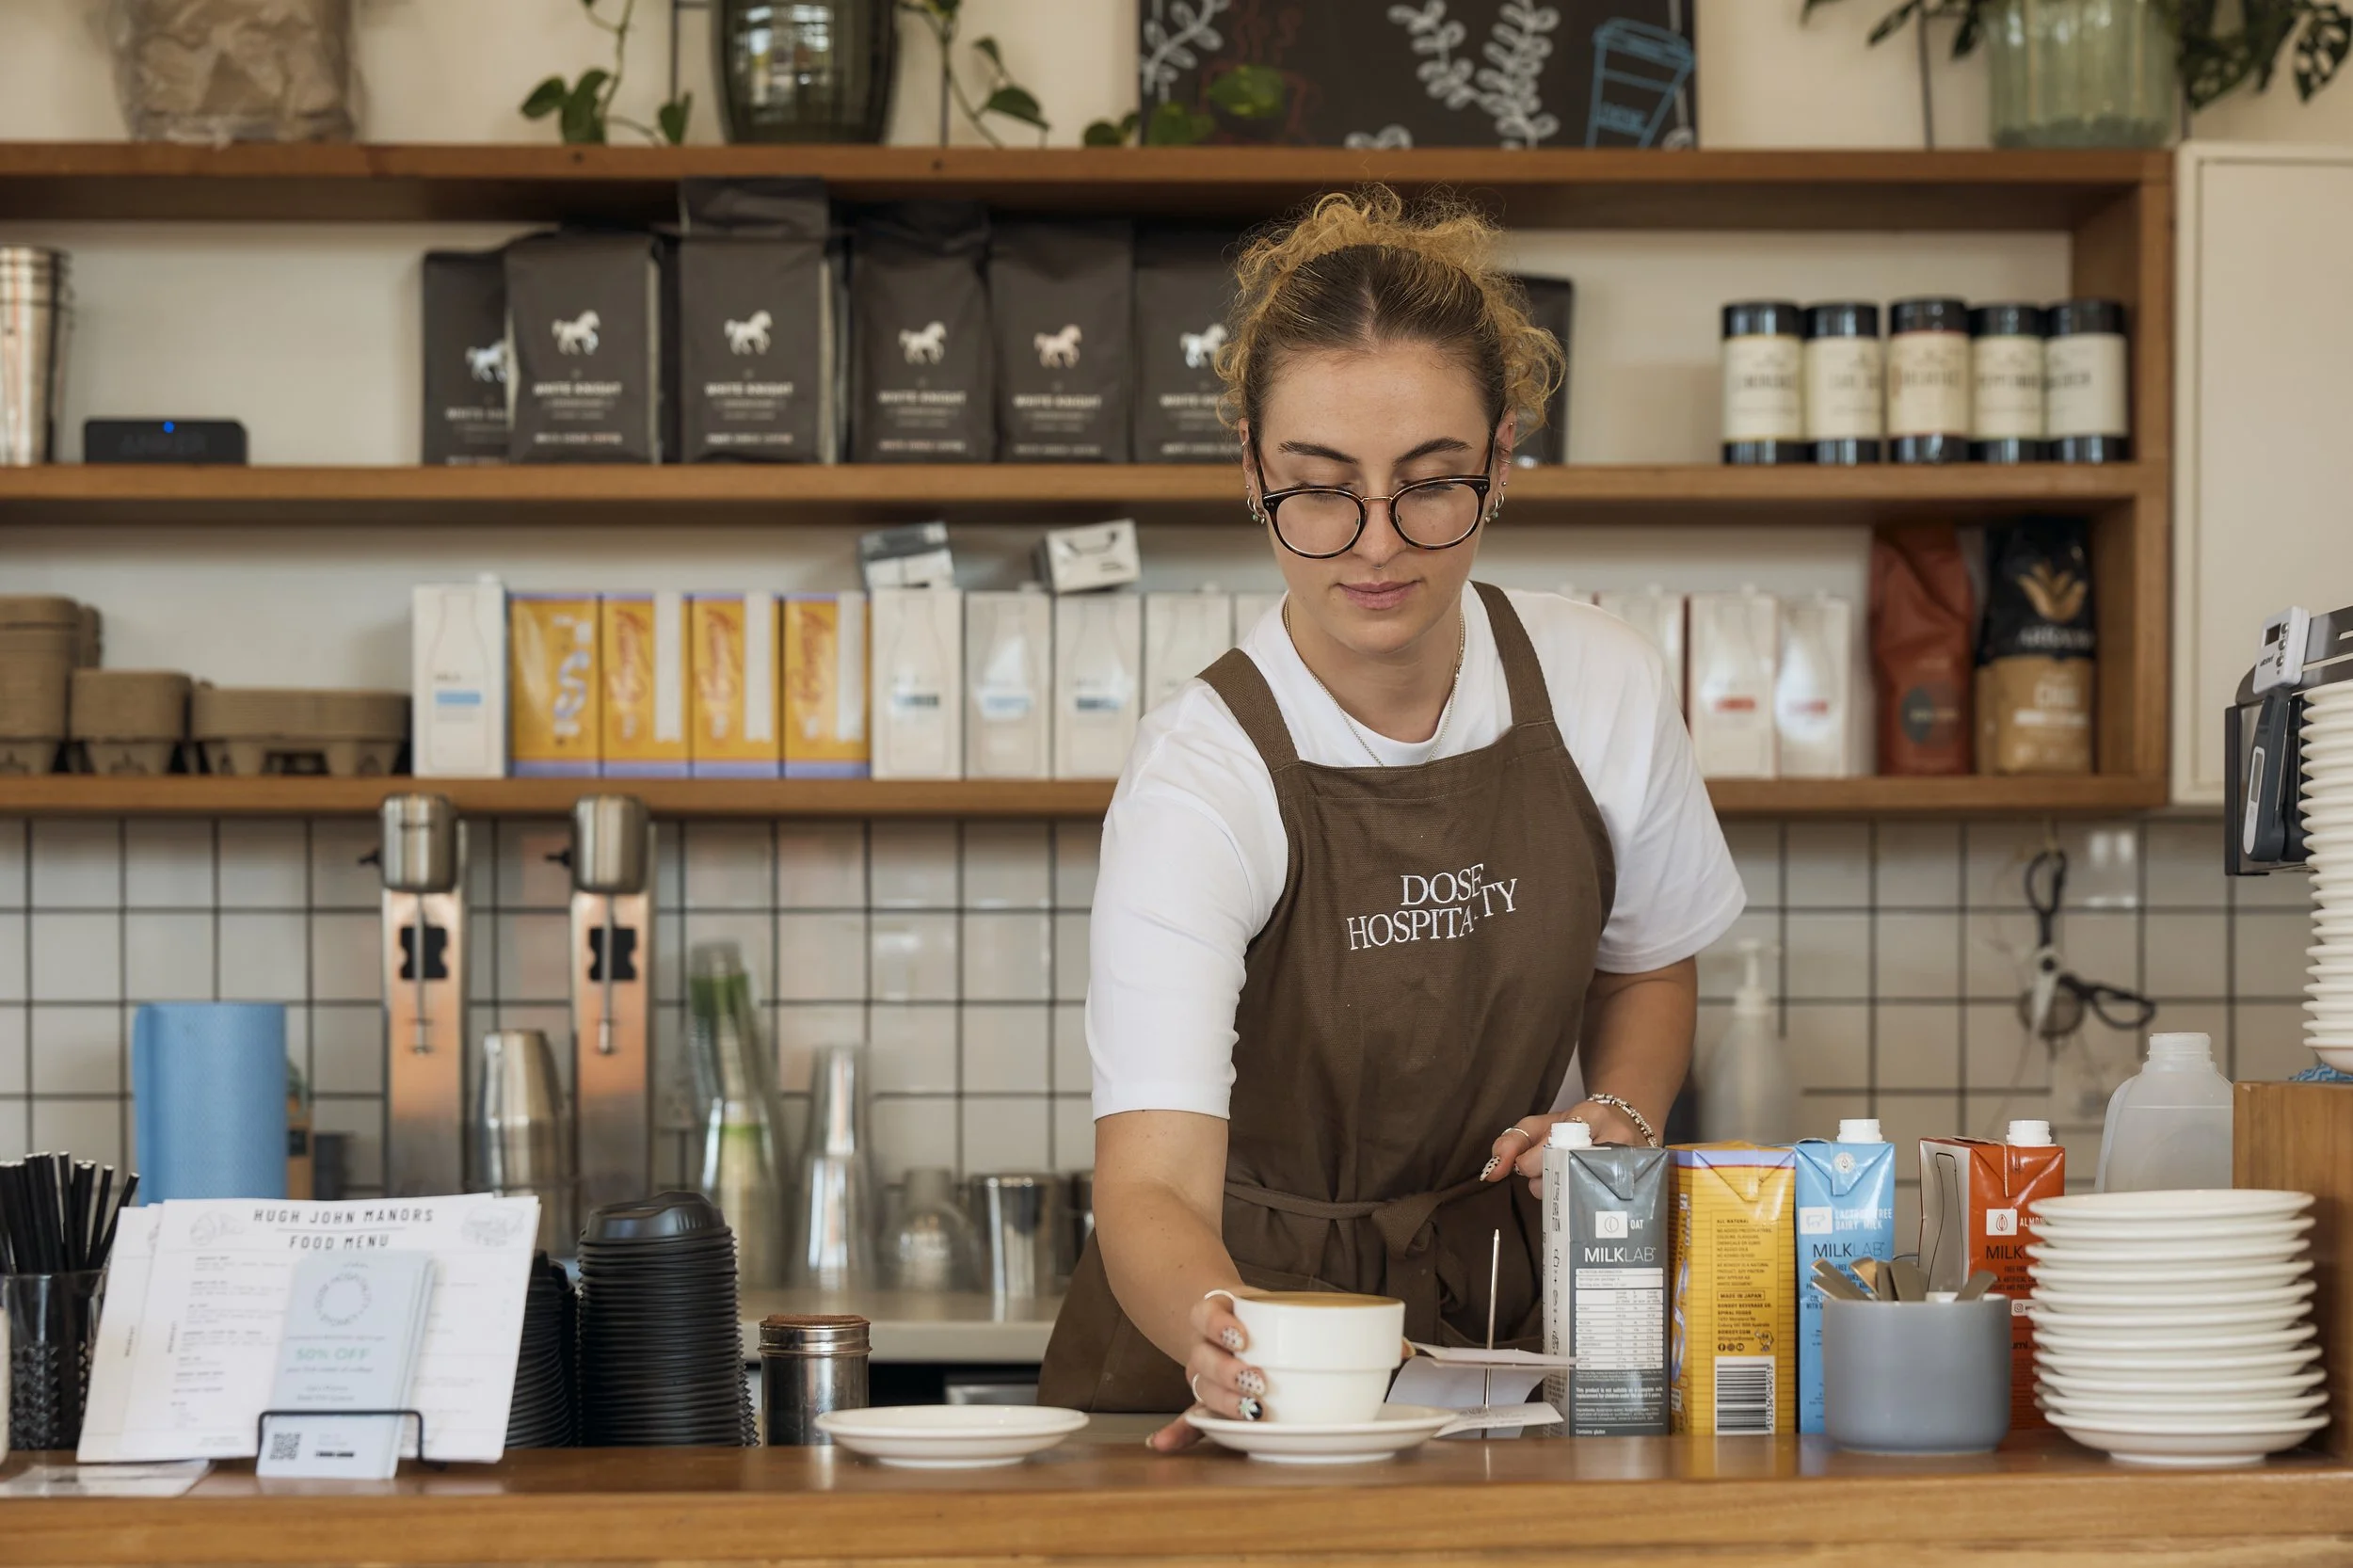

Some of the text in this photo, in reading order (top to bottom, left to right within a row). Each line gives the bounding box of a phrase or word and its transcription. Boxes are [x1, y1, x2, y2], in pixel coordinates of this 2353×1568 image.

[1401, 863, 1484, 905] DOSE
[1347, 878, 1518, 951] HOSPITATY
[253, 1208, 434, 1224] HUGH JOHN MANORS
[2020, 1216, 2044, 1227] ALMO
[1630, 1219, 1644, 1230] OAT
[1864, 1219, 1882, 1230] MILK
[289, 1235, 390, 1250] FOOD MENU
[1813, 1242, 1883, 1257] MILKLAB
[1584, 1247, 1655, 1262] MILKLAB
[1986, 1245, 2027, 1260] MILK
[334, 1347, 371, 1361] OFF
